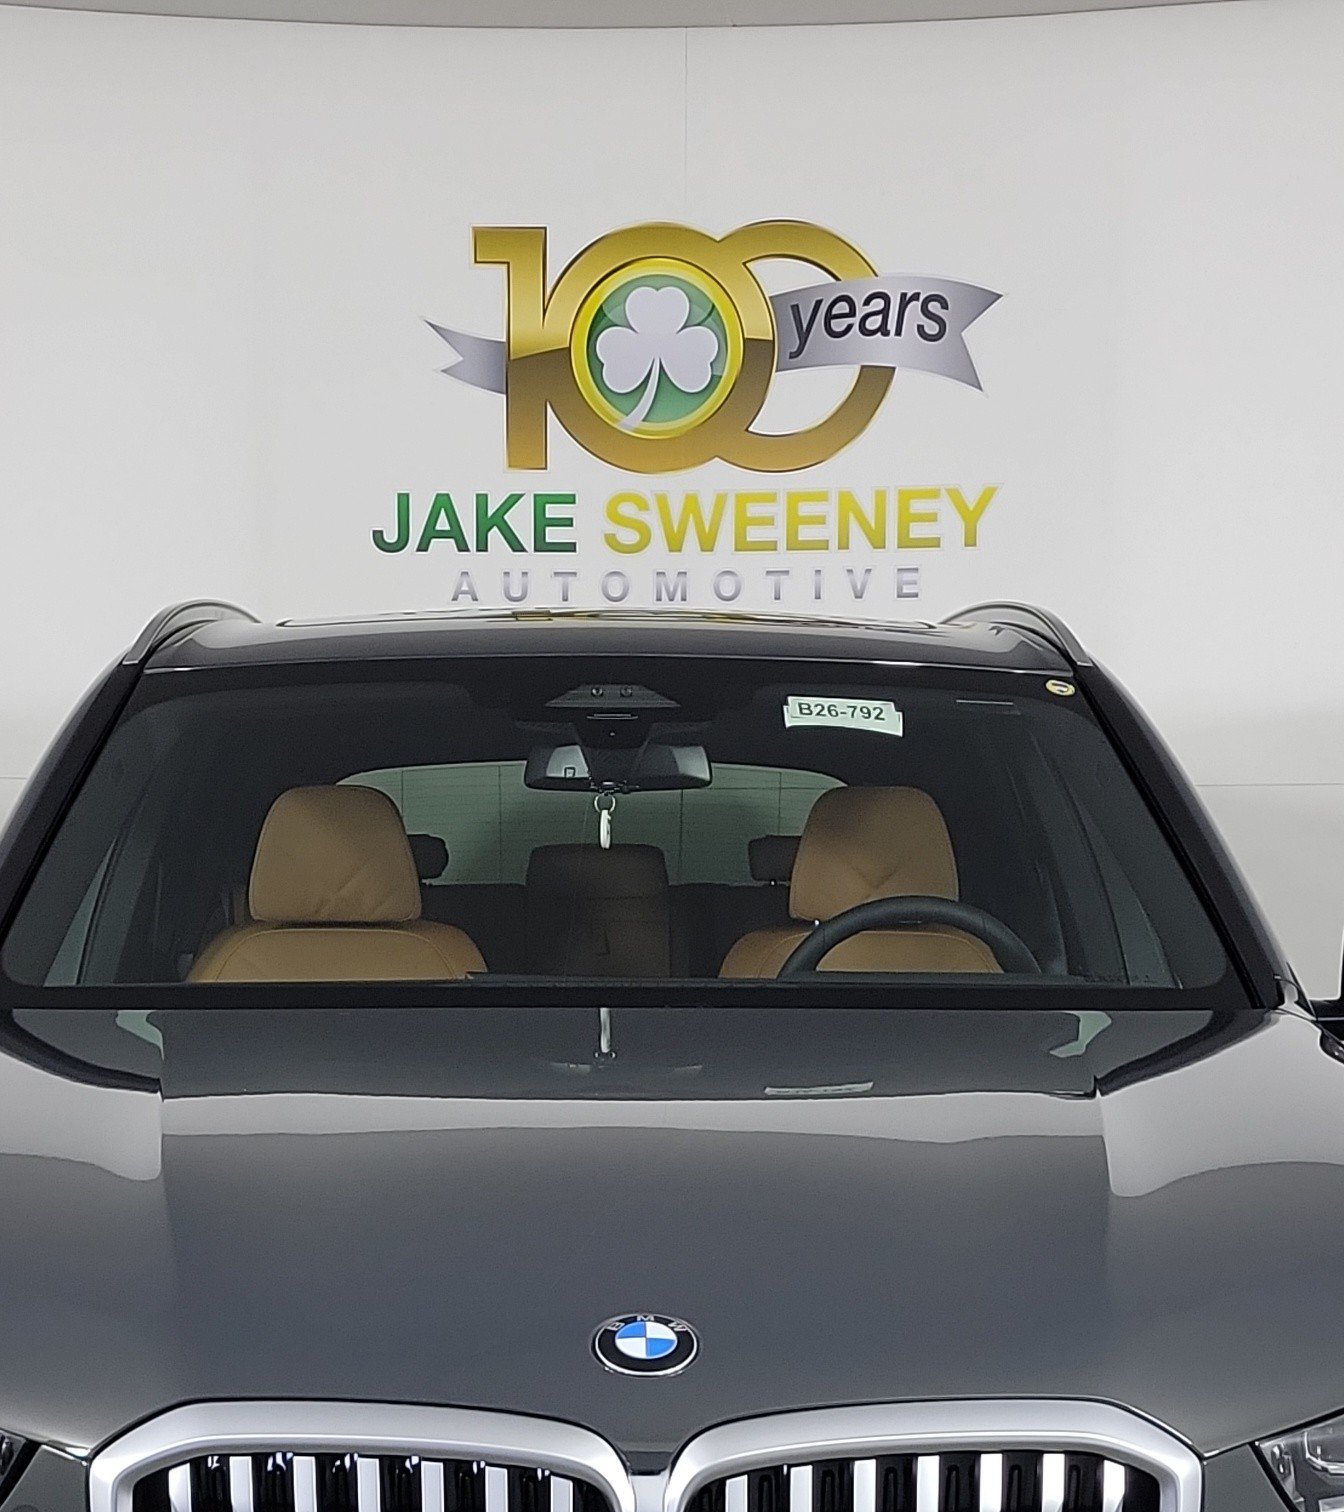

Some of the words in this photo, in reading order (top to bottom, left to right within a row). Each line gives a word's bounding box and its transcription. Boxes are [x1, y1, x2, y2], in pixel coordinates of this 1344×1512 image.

[470, 218, 897, 474] 100
[789, 290, 950, 360] years
[371, 492, 578, 554] JAKE
[602, 485, 1000, 554] SWEENEY
[451, 567, 921, 602] AUTOMOTIVE
[797, 701, 886, 721] B26-792
[607, 1314, 688, 1331] BMW
